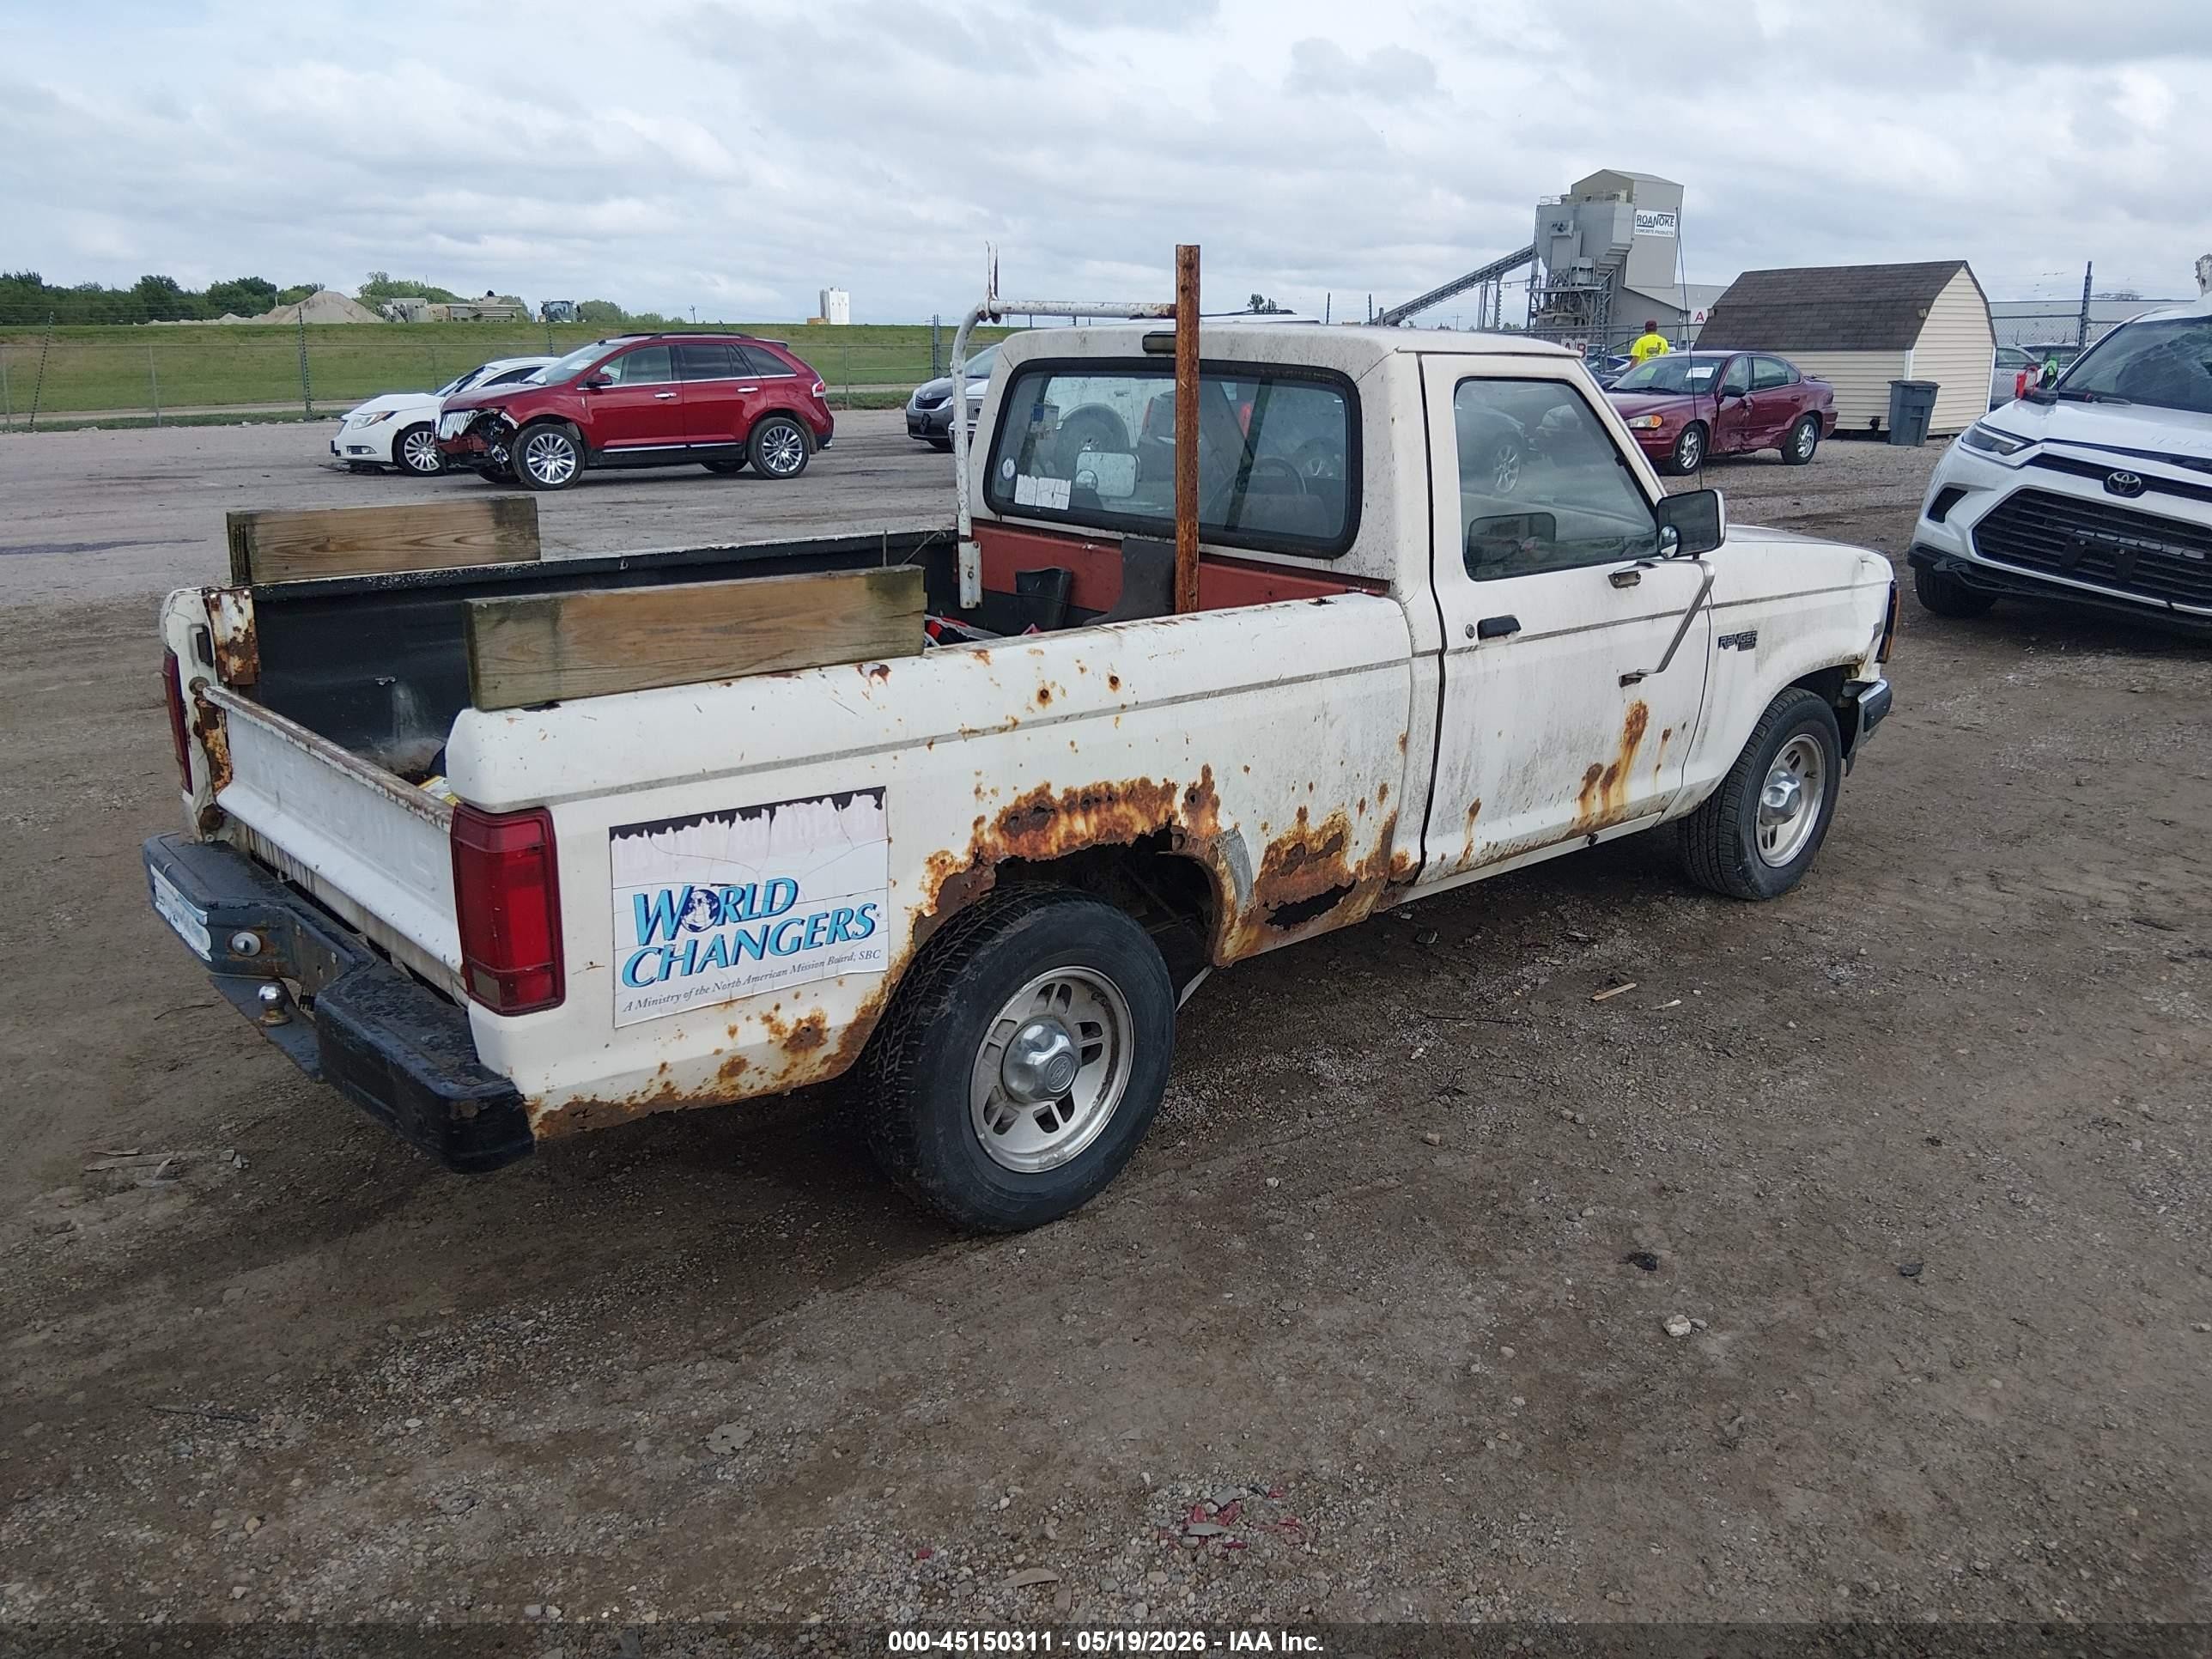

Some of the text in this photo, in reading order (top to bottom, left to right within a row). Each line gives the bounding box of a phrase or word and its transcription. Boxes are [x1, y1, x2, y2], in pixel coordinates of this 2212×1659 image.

[1637, 214, 1674, 228] ROANOKE
[1694, 312, 1705, 322] A
[1718, 630, 1758, 651] RANGER
[622, 902, 877, 988] CHANGERS
[623, 1000, 633, 1012] A
[635, 993, 682, 1010] Ministry
[683, 988, 695, 1000] of
[695, 985, 710, 997] the
[713, 977, 742, 993] North
[743, 968, 787, 985] American
[789, 959, 825, 975] Mission
[859, 949, 881, 960] SBC
